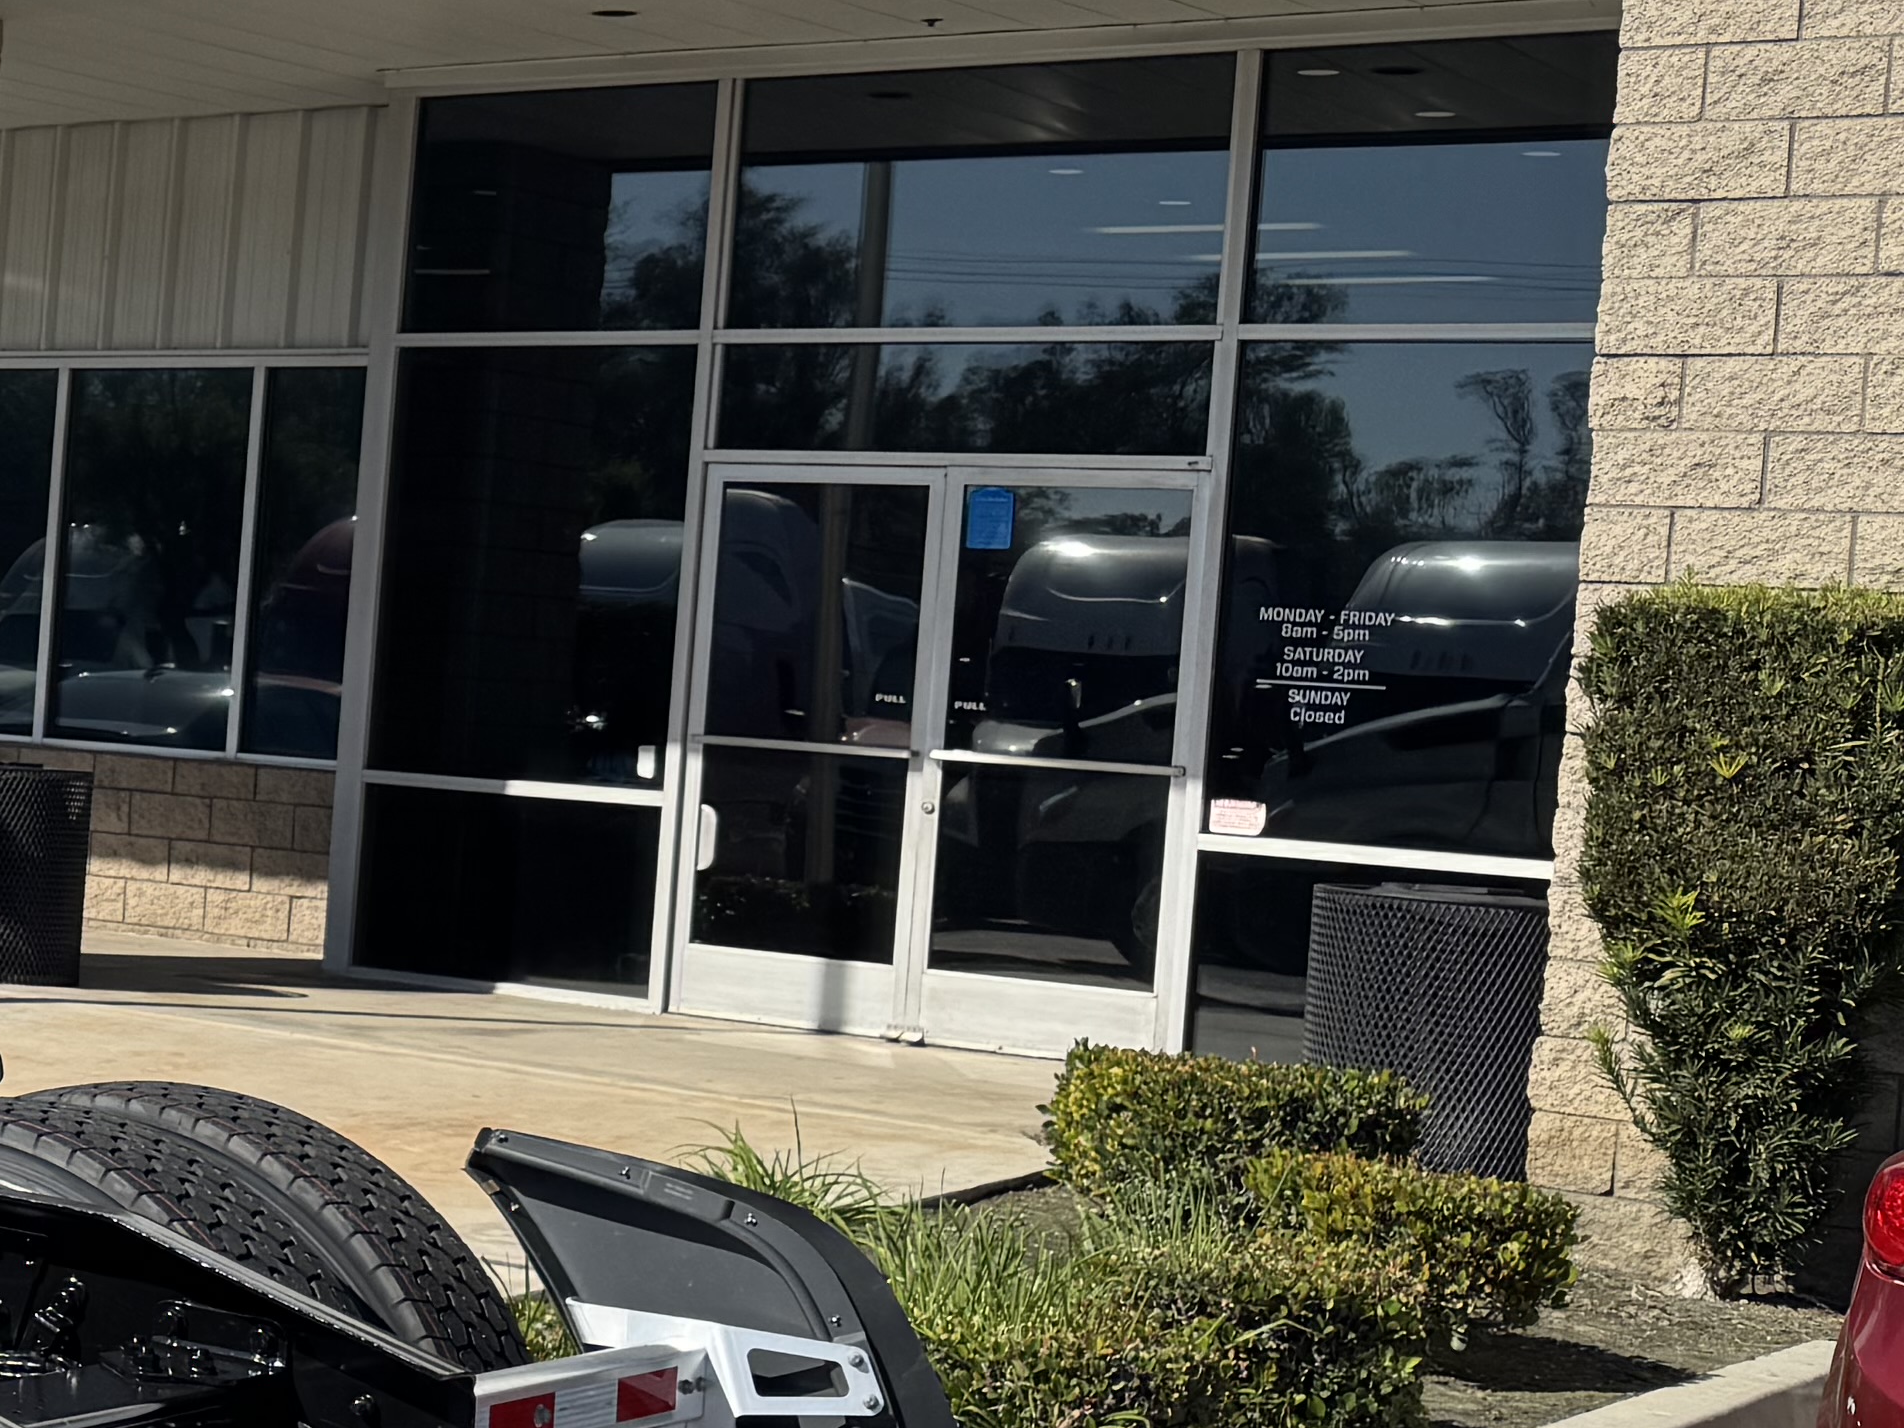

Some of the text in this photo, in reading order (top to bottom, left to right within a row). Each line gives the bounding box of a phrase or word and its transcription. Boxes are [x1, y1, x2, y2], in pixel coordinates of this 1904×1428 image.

[1259, 606, 1325, 623] MONDAY
[1340, 610, 1396, 627] FRIDAY
[1281, 623, 1317, 639] 8am
[1332, 625, 1370, 642] 5pm
[1283, 646, 1365, 663] SATURDAY
[1276, 662, 1317, 679] 10am
[1332, 665, 1370, 682] 2pm
[875, 693, 906, 704] PULL
[954, 701, 986, 711] PULL
[1288, 688, 1351, 706] SUNDAY
[1290, 707, 1345, 725] Closed
